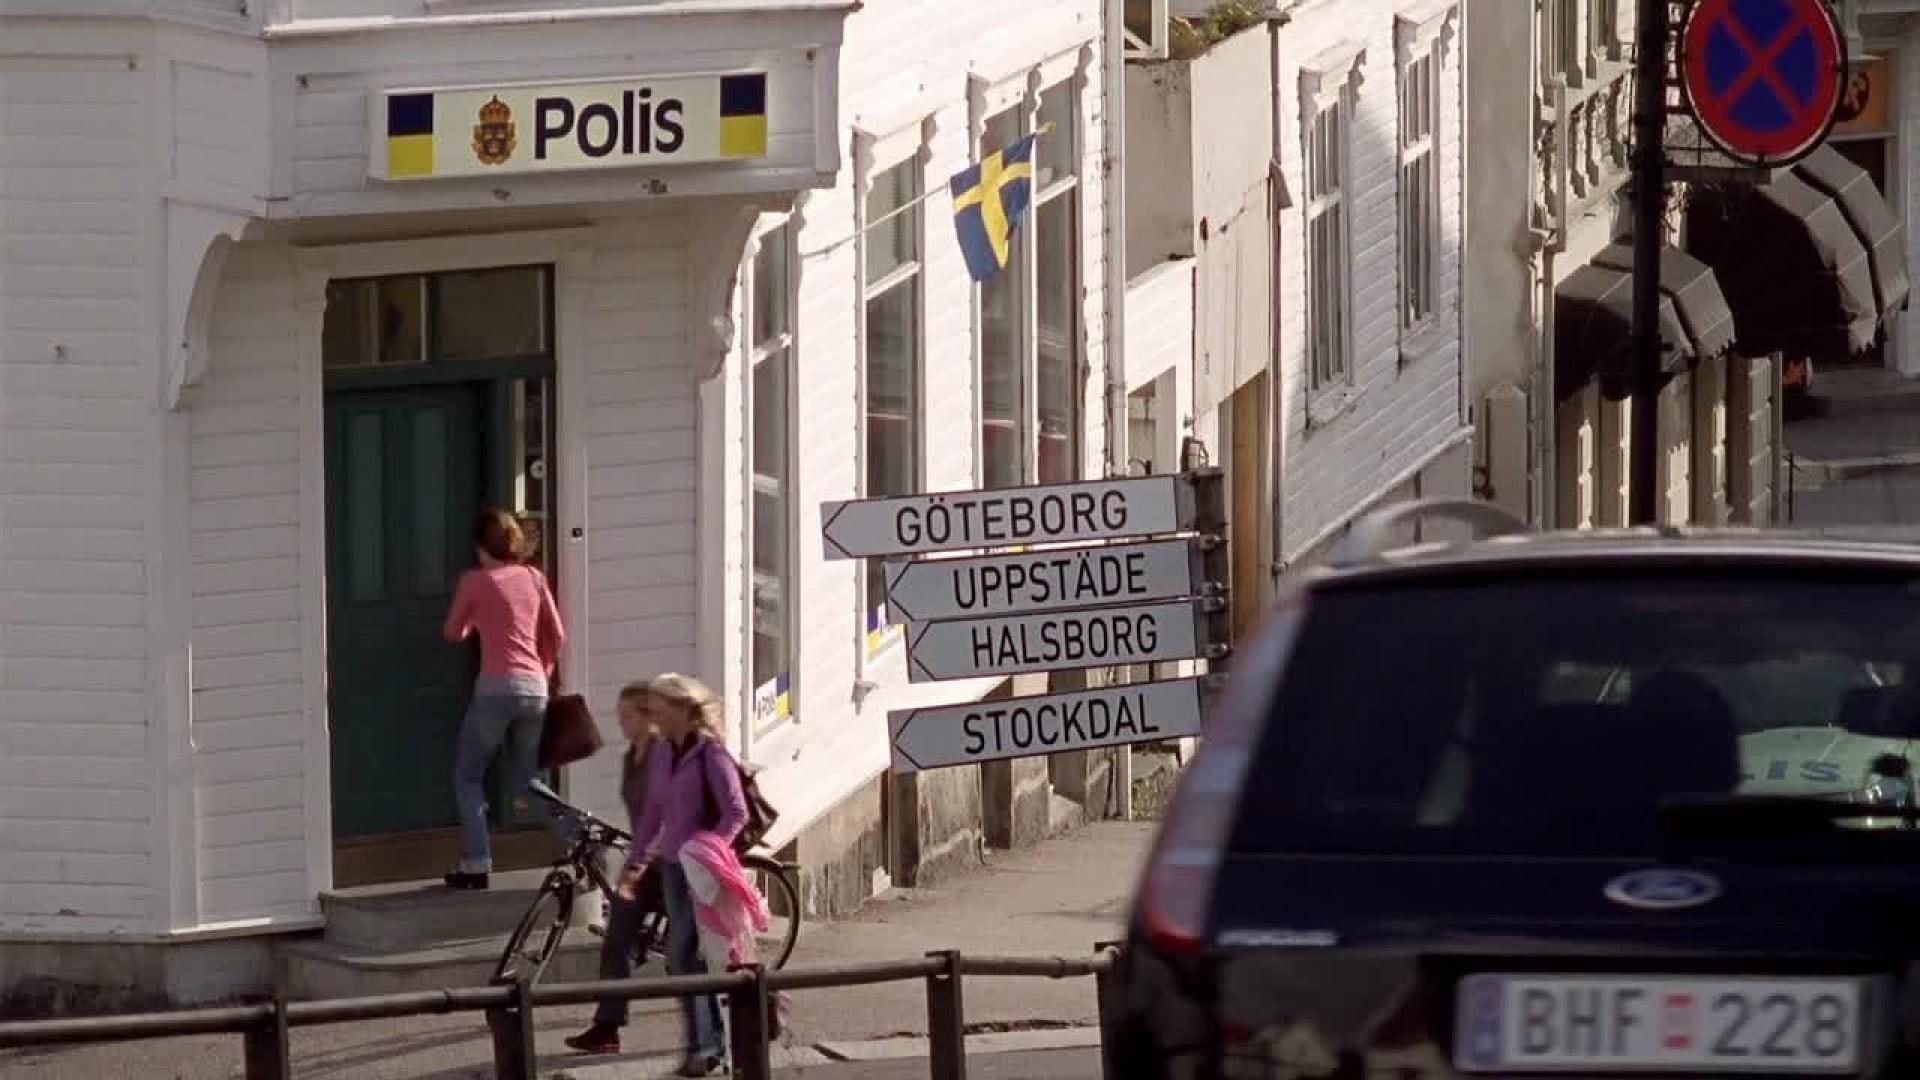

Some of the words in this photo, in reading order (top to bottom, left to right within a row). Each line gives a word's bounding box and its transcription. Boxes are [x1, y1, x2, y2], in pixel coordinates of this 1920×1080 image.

[534, 87, 685, 160] Polis
[896, 489, 1128, 547] GÖTEBORG
[952, 551, 1147, 609] UPPSTÄDE
[971, 613, 1158, 669] HALSBORG
[962, 693, 1160, 754] STOCKDAL
[1518, 987, 1646, 1057] BHF
[1709, 991, 1847, 1058] 228
